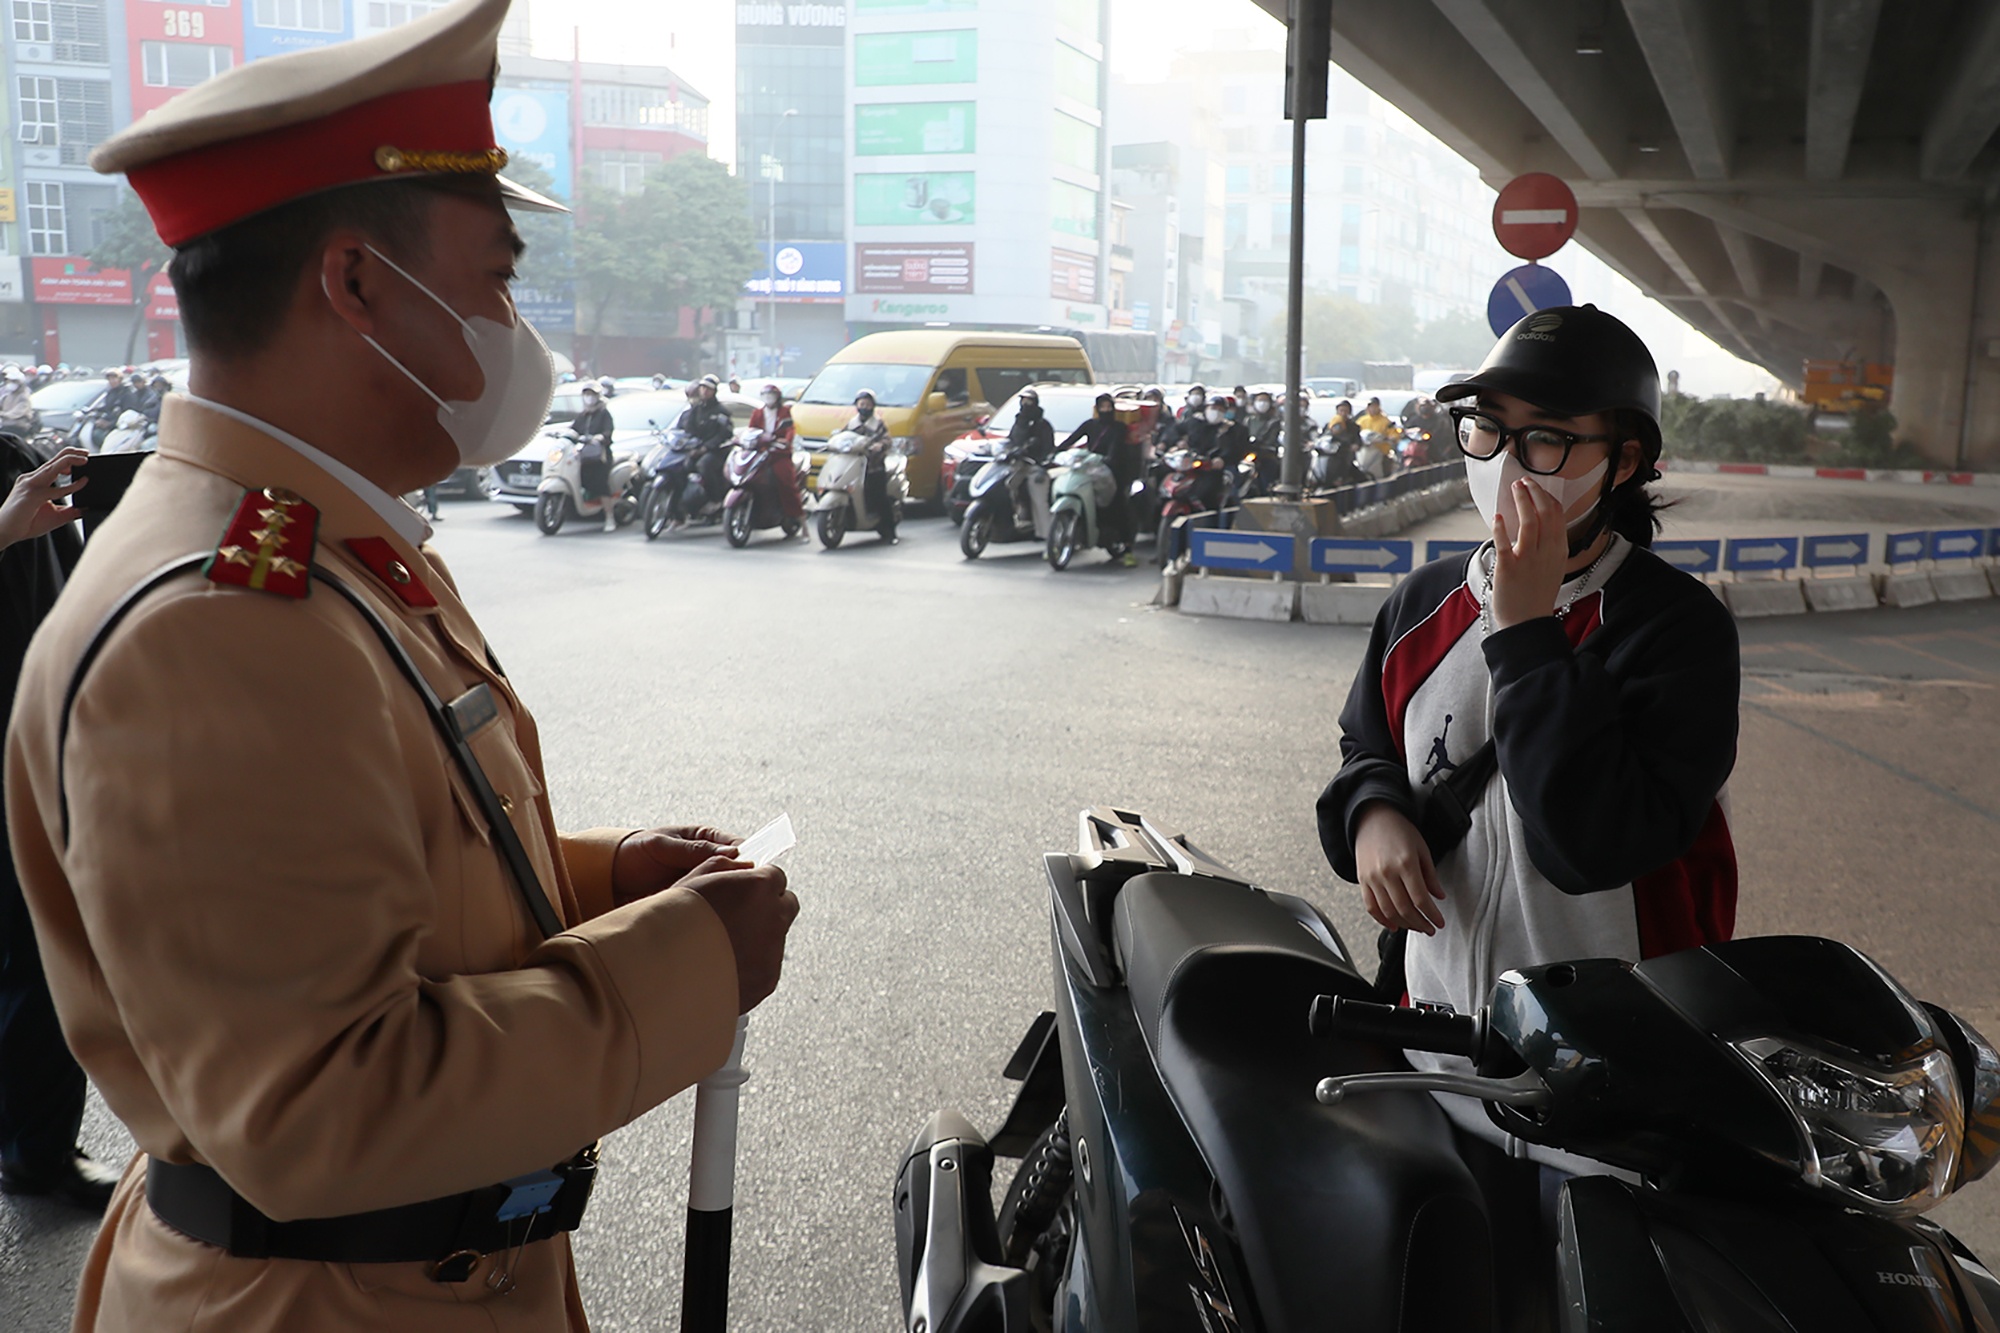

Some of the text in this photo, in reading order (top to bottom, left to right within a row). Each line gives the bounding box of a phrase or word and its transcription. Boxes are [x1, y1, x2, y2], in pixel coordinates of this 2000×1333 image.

[163, 9, 205, 39] 369
[877, 300, 948, 317] Kangaroo
[1517, 331, 1557, 342] adidas
[1876, 1271, 1943, 1289] HONDA
